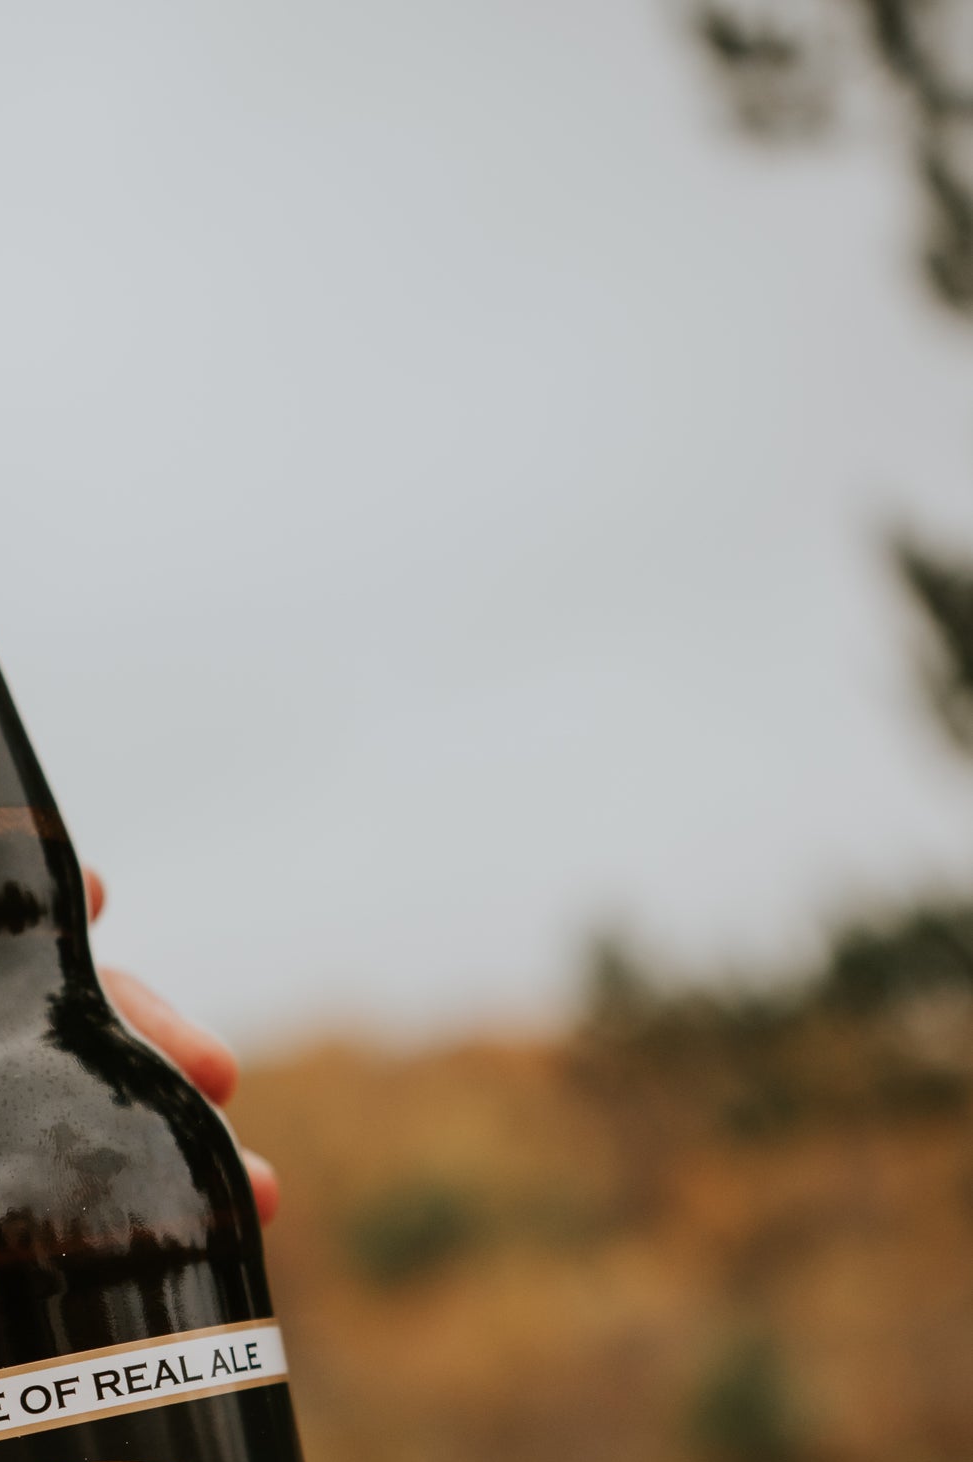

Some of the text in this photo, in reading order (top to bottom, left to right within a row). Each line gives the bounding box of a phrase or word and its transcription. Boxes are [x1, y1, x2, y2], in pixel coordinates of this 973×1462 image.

[19, 1374, 80, 1415] OF
[91, 1355, 204, 1401] REAL
[210, 1341, 263, 1378] ALE
